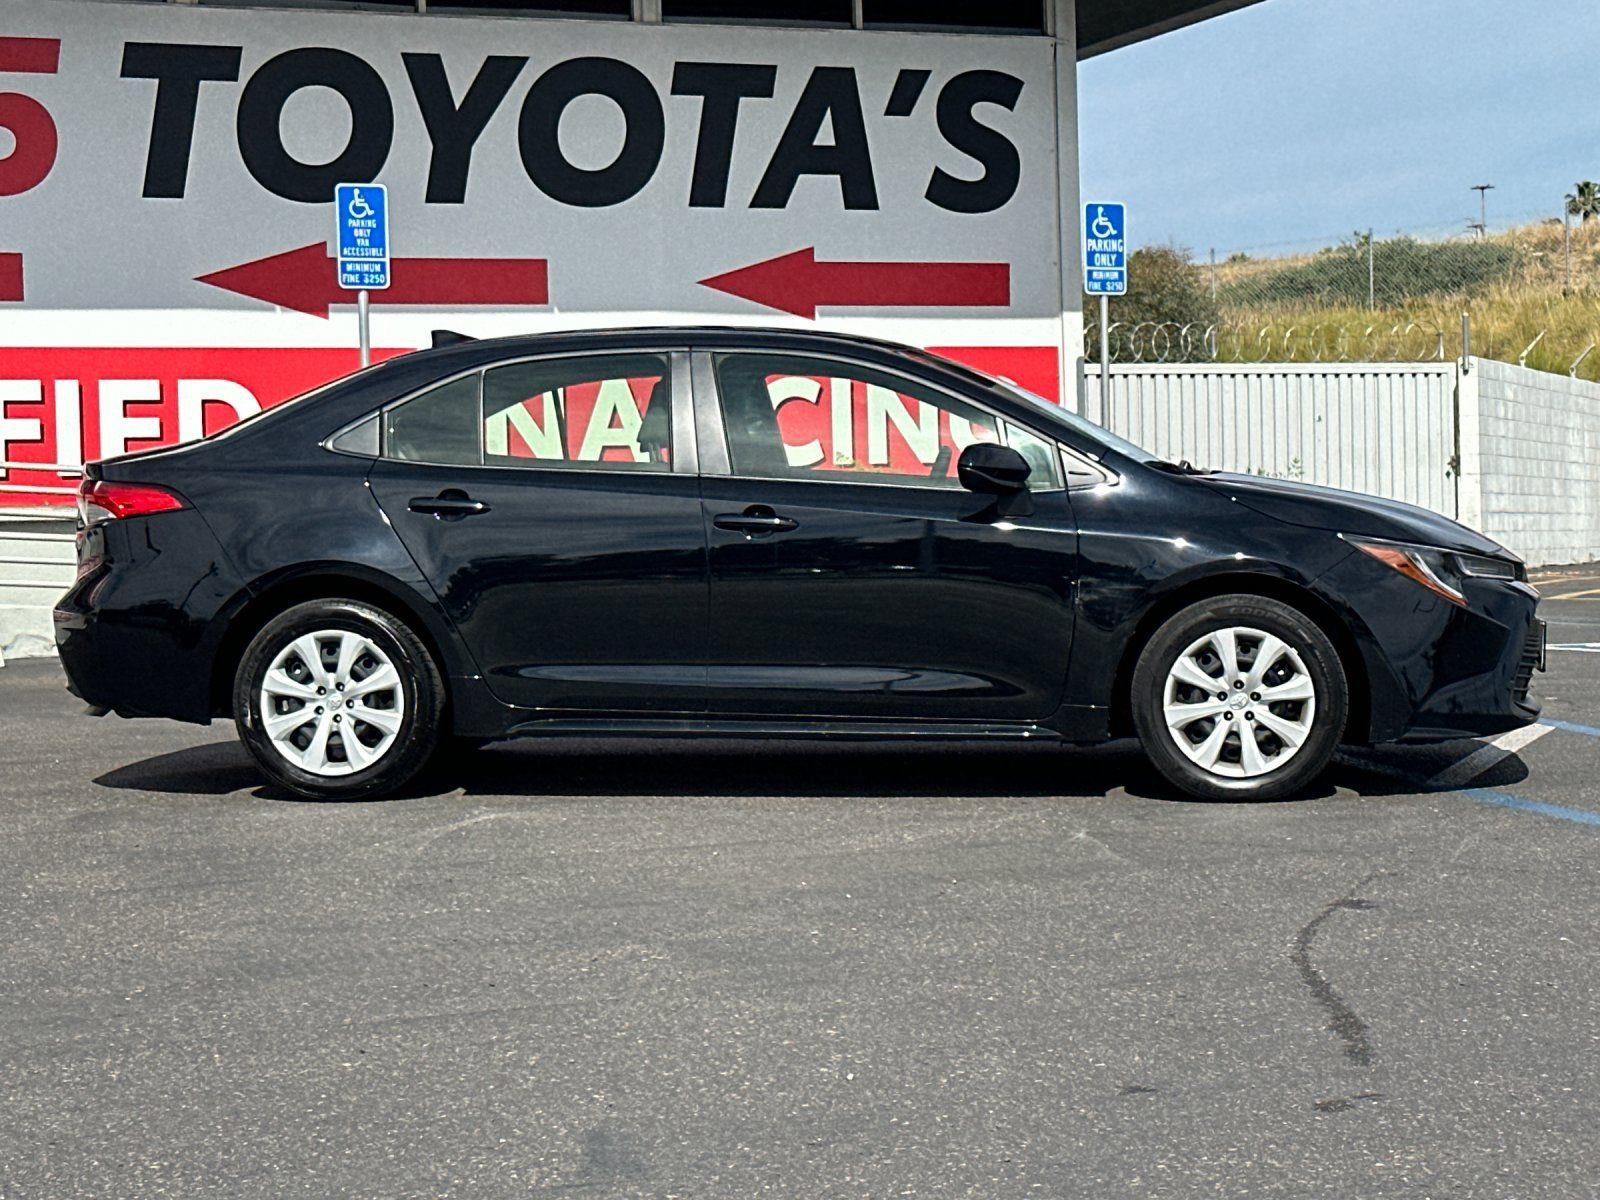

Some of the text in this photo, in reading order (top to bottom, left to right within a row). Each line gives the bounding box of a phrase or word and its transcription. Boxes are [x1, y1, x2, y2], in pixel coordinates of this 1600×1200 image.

[120, 42, 1026, 214] TOYOTA'S
[347, 218, 377, 229] PARKING
[353, 228, 371, 238] ONLY
[356, 238, 370, 247] VAN
[1087, 238, 1123, 253] PARKING
[343, 246, 384, 257] ACCESSIBLE
[1093, 253, 1117, 267] ONLY
[346, 262, 382, 273] MINIMUM
[342, 273, 386, 284] FINE $250
